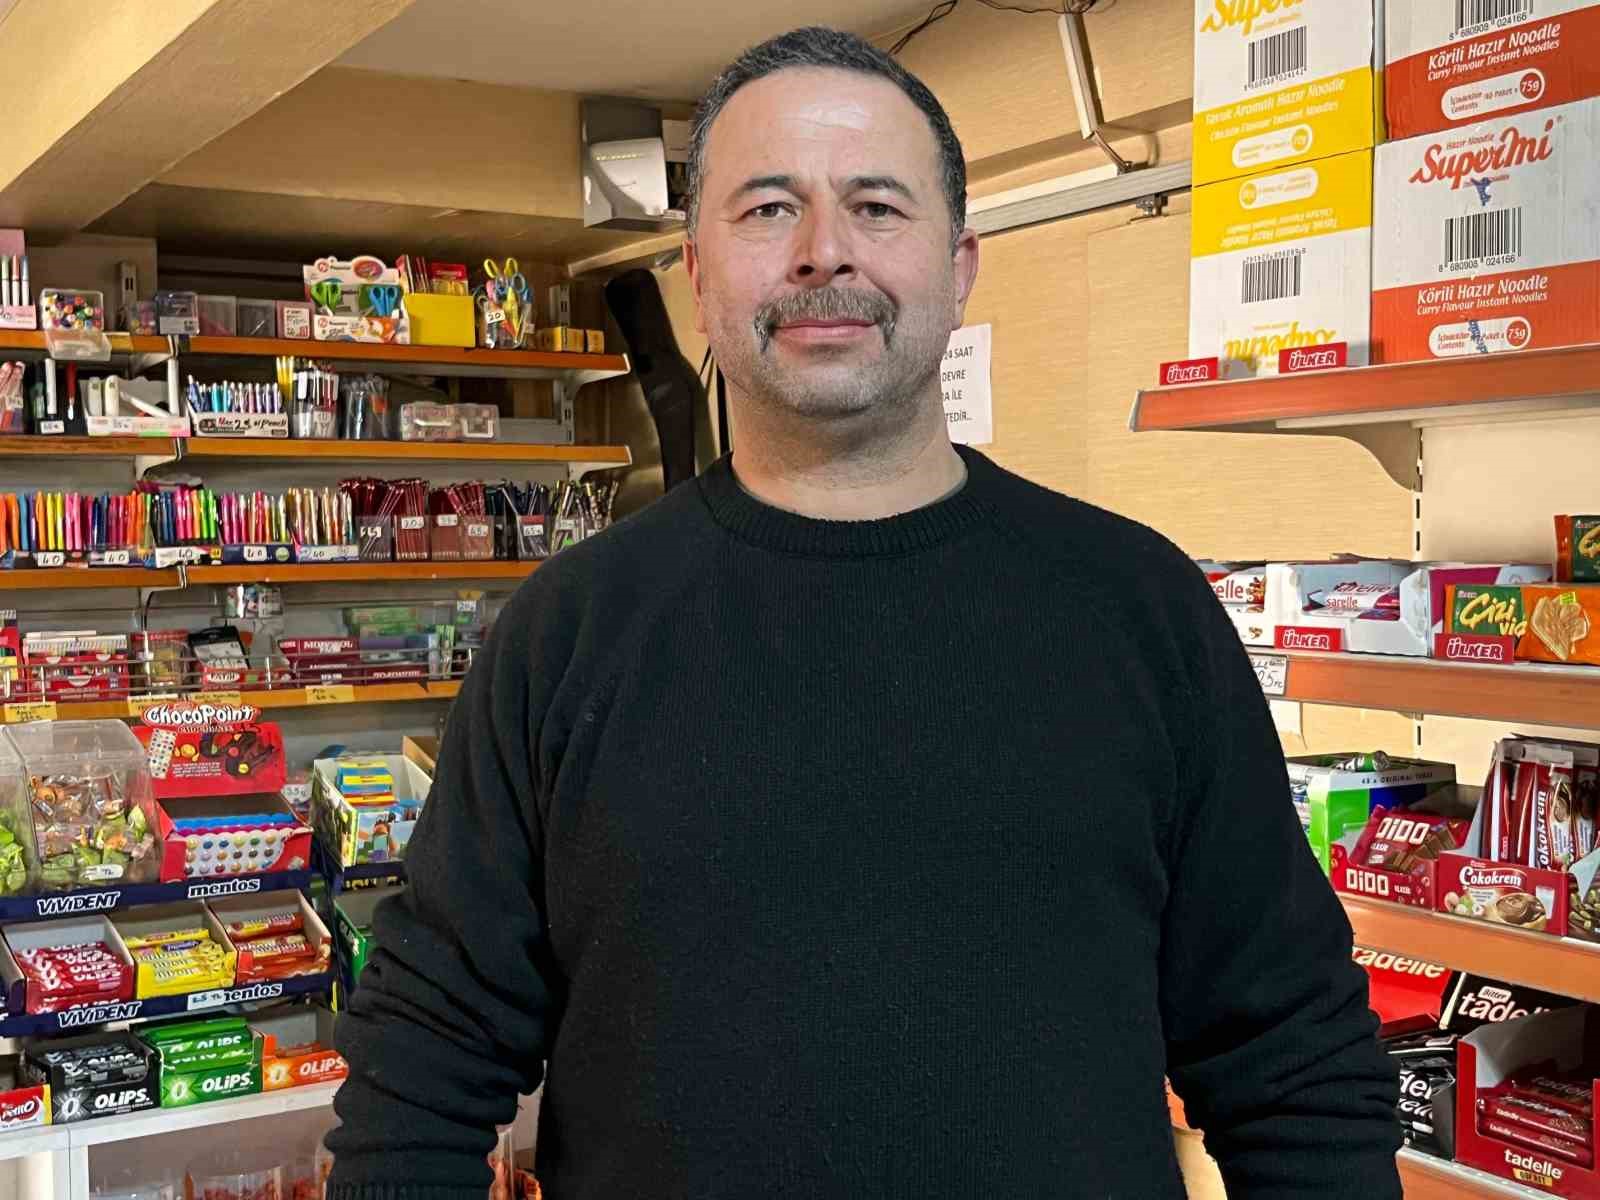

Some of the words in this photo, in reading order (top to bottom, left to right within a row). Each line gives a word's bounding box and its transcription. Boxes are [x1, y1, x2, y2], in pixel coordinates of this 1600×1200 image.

[1428, 47, 1465, 70] Körili
[1468, 38, 1506, 58] Hazır
[1509, 22, 1561, 48] Noodle
[1427, 69, 1450, 81] Curry
[1452, 60, 1484, 74] Flavour
[1487, 51, 1520, 66] Instant
[1523, 39, 1560, 57] Noodles
[1308, 78, 1345, 97] Noodle
[1521, 80, 1540, 93] 75g
[1467, 132, 1495, 145] Noodle
[1417, 286, 1454, 305] Körili
[1457, 283, 1494, 300] Hazır
[1497, 274, 1549, 295] Noodle
[1417, 303, 1441, 316] Curry
[1442, 300, 1475, 312] Flavour
[1476, 296, 1509, 307] Instant
[1511, 291, 1548, 304] Noodles
[1508, 328, 1526, 342] 75g
[954, 346, 973, 359] SAAT
[1289, 349, 1337, 370] ÜLKER
[942, 369, 966, 382] DEVRE
[1166, 365, 1208, 383] ÜLKER
[43, 554, 59, 564] 40
[108, 553, 126, 562] 40
[1327, 596, 1358, 609] sarelle
[1283, 629, 1330, 650] ÜLKER
[1447, 637, 1503, 661] ÜLKER
[145, 704, 255, 724] ChocoPoint
[188, 878, 261, 899] mentos
[1482, 987, 1507, 1000] Bitter
[1504, 1148, 1563, 1179] tadelle
